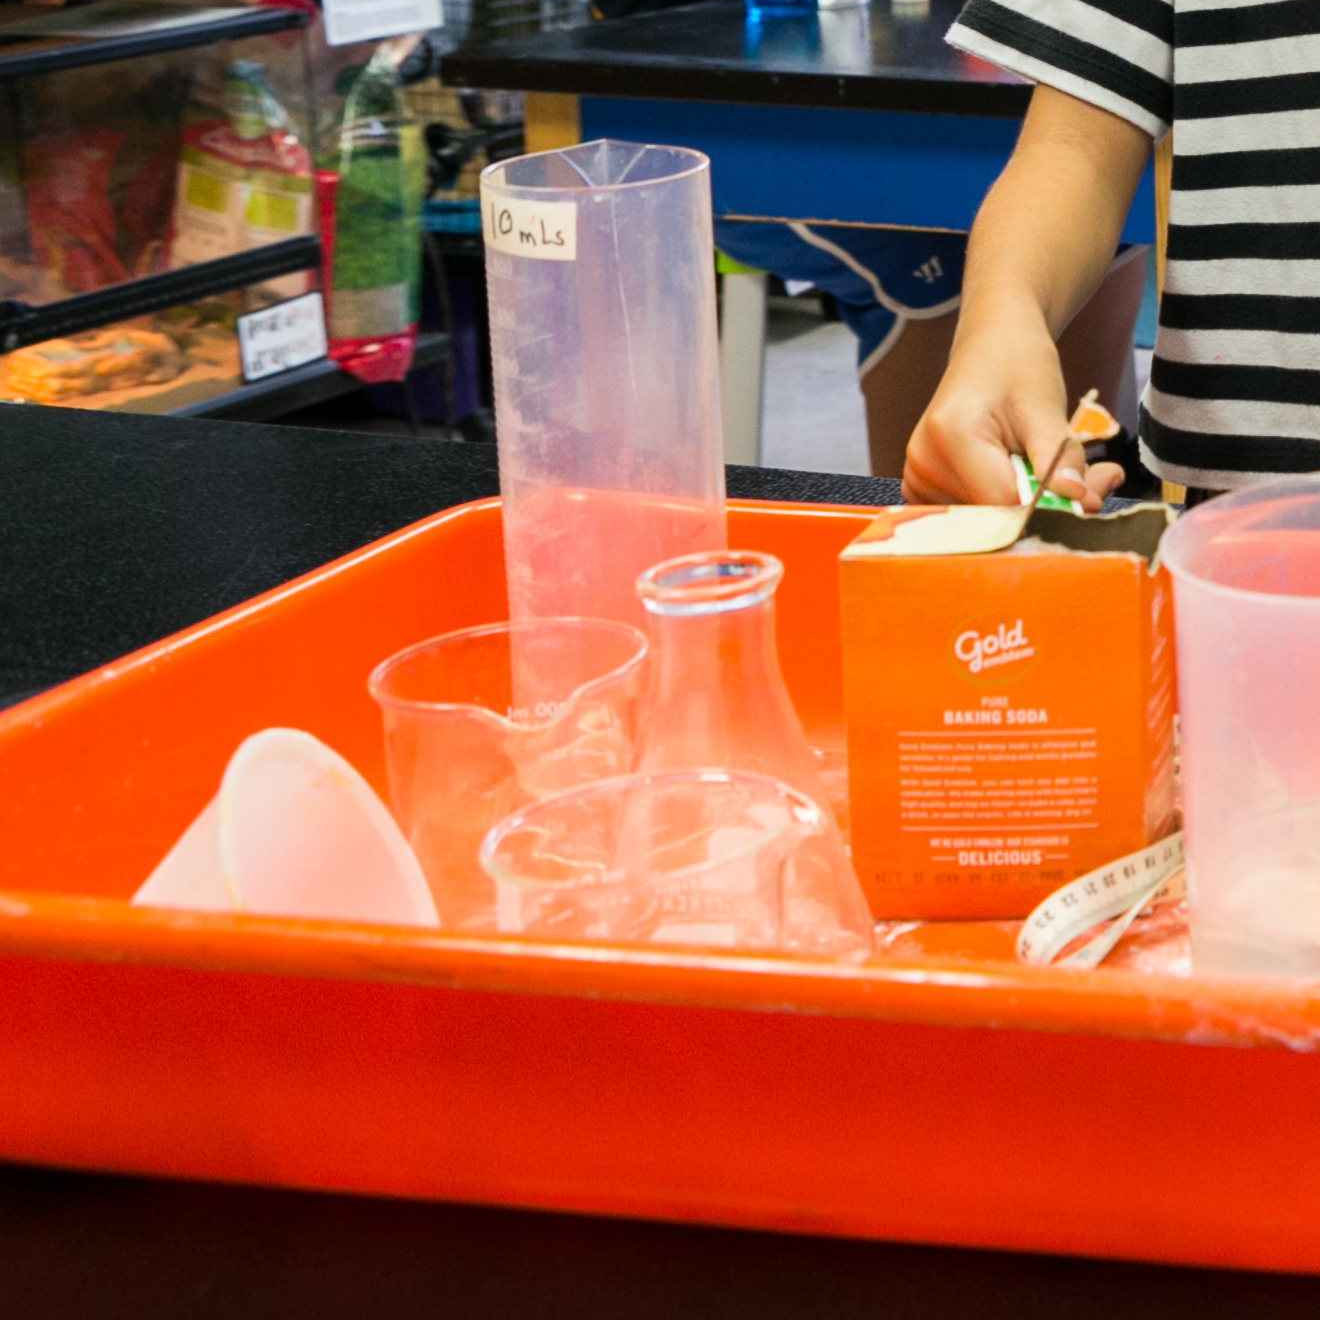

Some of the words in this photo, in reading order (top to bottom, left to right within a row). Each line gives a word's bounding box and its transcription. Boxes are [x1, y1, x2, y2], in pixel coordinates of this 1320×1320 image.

[489, 201, 513, 240] 10
[954, 618, 1028, 673] Gold
[981, 696, 1009, 709] PURE
[943, 710, 1003, 726] BAKING
[1006, 708, 1048, 725] SODA
[957, 848, 1043, 867] DELICIOUS
